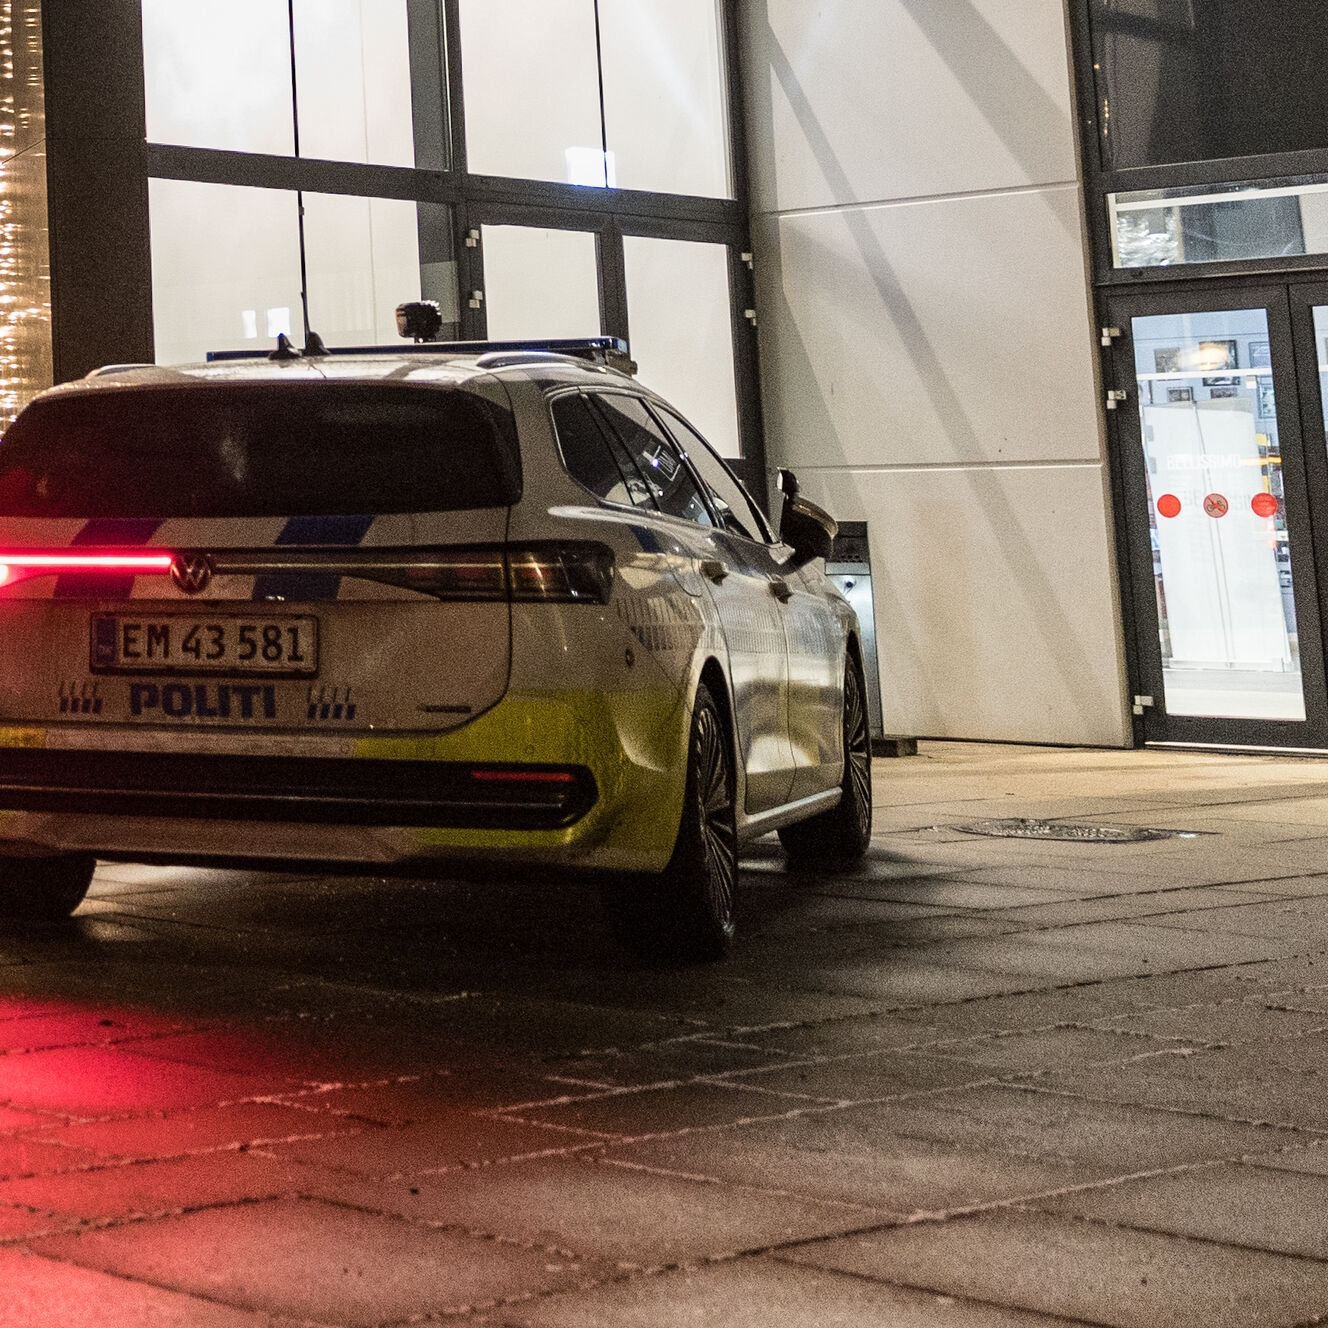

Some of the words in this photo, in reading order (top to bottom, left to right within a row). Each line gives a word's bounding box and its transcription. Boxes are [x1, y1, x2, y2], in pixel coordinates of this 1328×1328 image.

[122, 623, 171, 660] EM
[181, 624, 226, 660] 43
[238, 625, 305, 663] 581
[129, 682, 276, 719] POLITI
